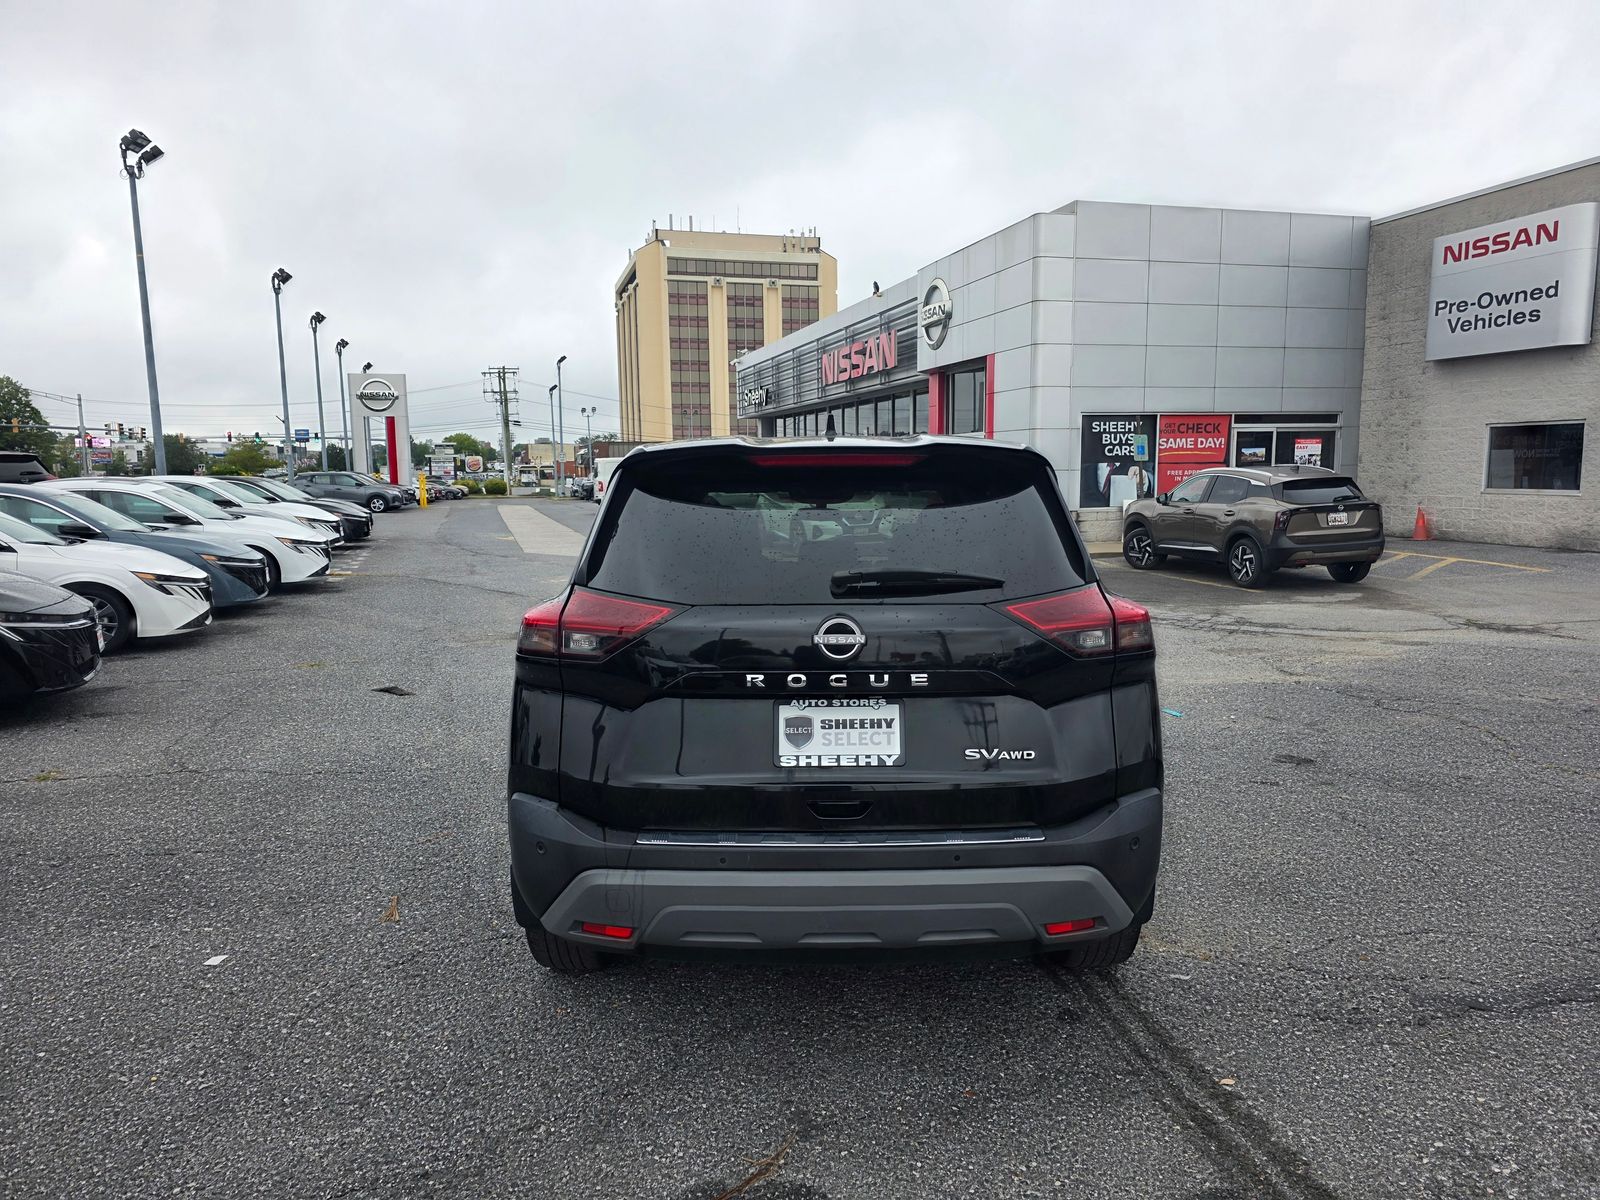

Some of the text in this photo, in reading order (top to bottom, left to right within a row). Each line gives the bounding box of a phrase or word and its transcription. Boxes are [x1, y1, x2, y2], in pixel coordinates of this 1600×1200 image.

[1442, 220, 1560, 265] NISSAN
[1434, 279, 1560, 317] Pre-Owned
[921, 303, 946, 321] SSAN
[1447, 308, 1542, 334] Vehicles
[821, 328, 898, 386] NISSAN
[744, 386, 768, 407] Sheehy
[1177, 422, 1221, 434] CHECK
[1102, 433, 1135, 444] BUYS
[1159, 437, 1225, 449] SAME DAY!
[1104, 445, 1135, 456] CARS
[814, 636, 866, 644] NISSAN
[745, 673, 929, 688] ROGUE
[790, 699, 887, 707] AUTO STORES
[820, 718, 895, 730] SHEEHY
[822, 731, 895, 747] SELECT
[780, 754, 899, 767] SHEEHY
[964, 748, 1035, 760] SV AWD
